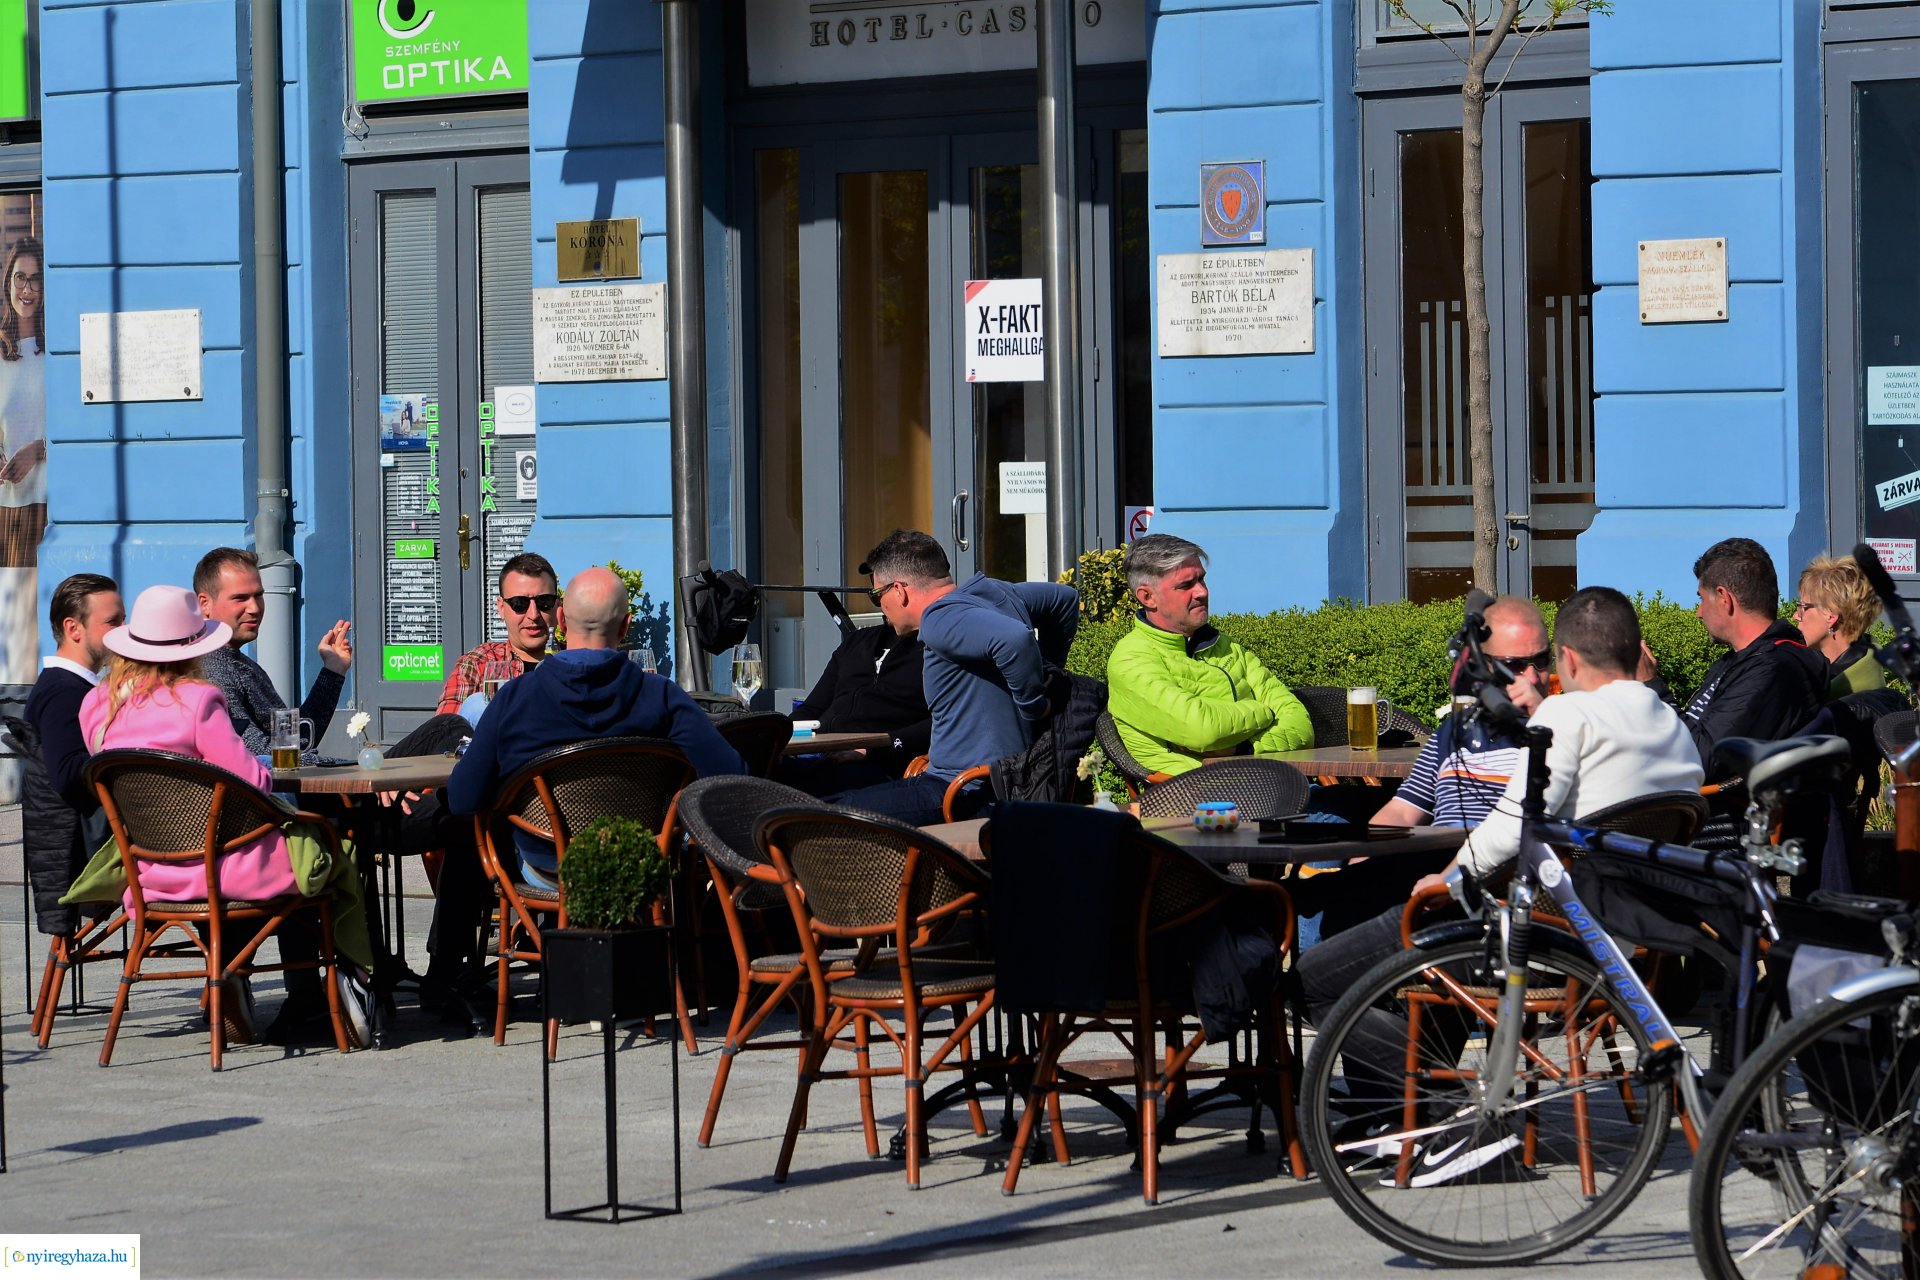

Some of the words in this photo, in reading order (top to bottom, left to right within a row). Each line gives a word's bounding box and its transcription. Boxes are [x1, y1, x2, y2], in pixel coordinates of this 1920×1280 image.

[810, 14, 933, 46] HOTEL
[955, 0, 1101, 35] CASO
[386, 39, 460, 57] SZEMFÉNY
[383, 56, 512, 90] OPTIKA
[584, 224, 610, 234] HOTEL
[570, 236, 624, 248] KORONA
[1202, 260, 1212, 269] EZ
[1255, 268, 1298, 277] NAGYTERMÉBEN
[1238, 278, 1284, 286] HANGVERSENYT
[571, 290, 580, 298] EZ
[1192, 287, 1238, 304] BARTÓK
[1242, 286, 1276, 302] BÉLA
[1218, 304, 1244, 314] JANUÁR
[978, 304, 1041, 334] X-FAKT
[556, 328, 594, 344] KODÁLY
[600, 327, 640, 342] ZOLTÁN
[978, 337, 1044, 356] MEGHALLGA
[1884, 391, 1912, 399] KÖTELEZŐ
[1888, 401, 1916, 409] ÜZLETBEN
[426, 404, 440, 513] OPTIKA
[479, 402, 496, 512] OPTIKA
[1883, 477, 1920, 502] ZÁRVA
[400, 543, 427, 552] ZÁRVA
[389, 652, 440, 672] opticnet
[1563, 900, 1664, 1044] MISTRAL
